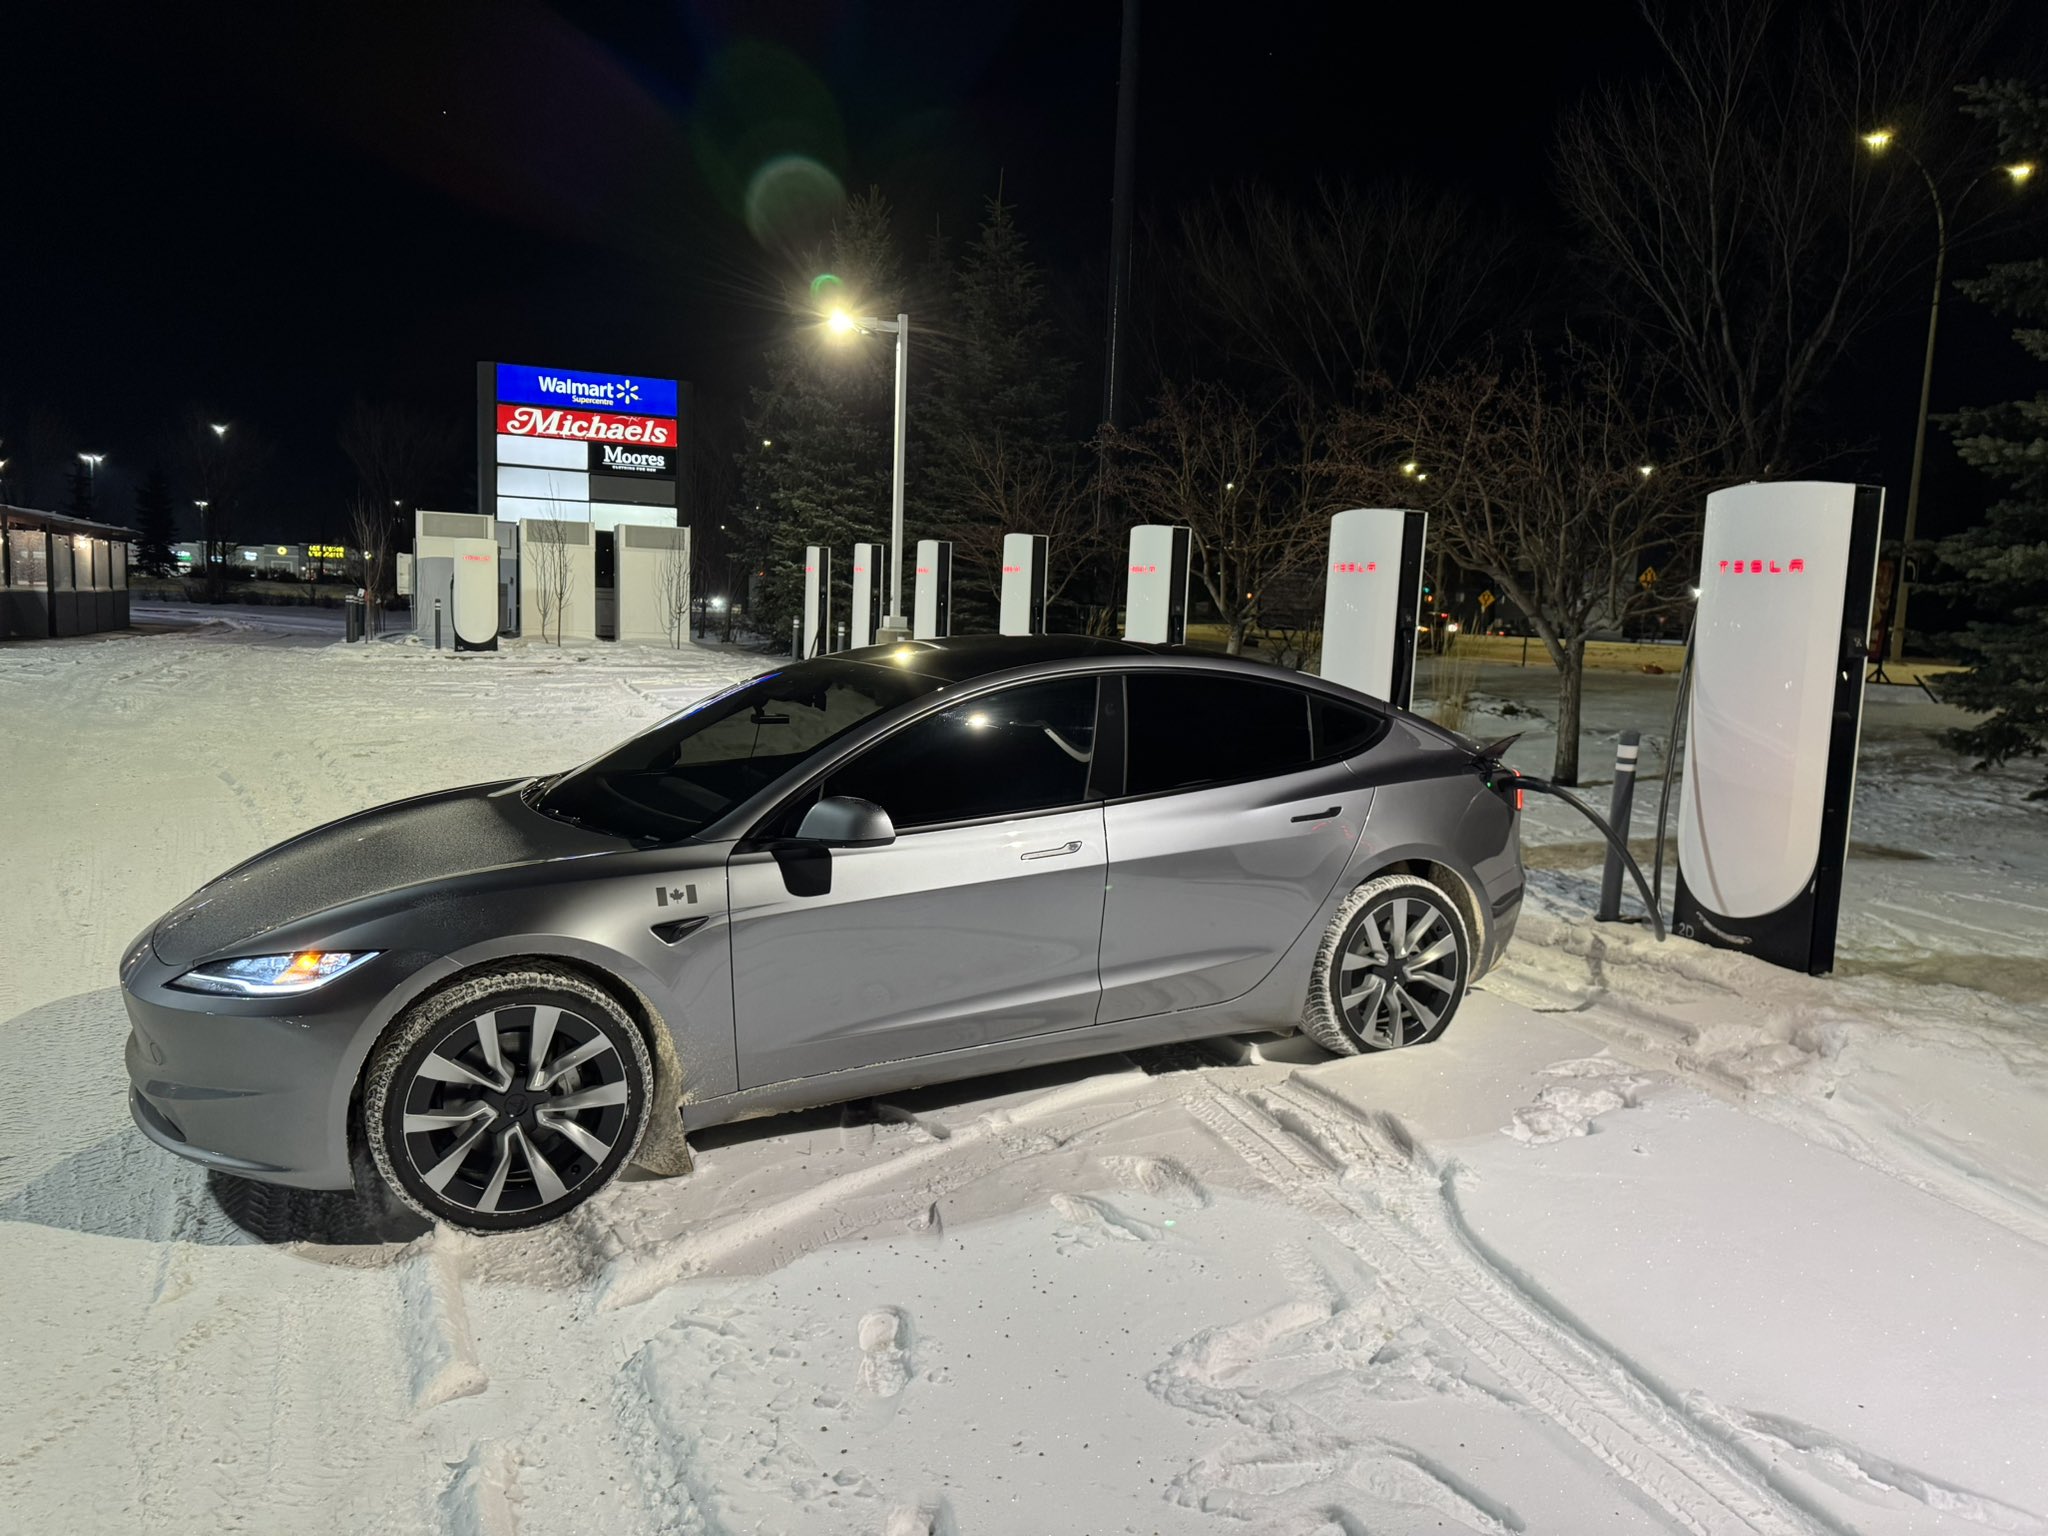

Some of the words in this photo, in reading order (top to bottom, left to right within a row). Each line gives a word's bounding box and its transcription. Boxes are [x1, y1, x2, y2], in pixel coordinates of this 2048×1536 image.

[538, 375, 614, 398] Walmart
[571, 395, 614, 406] Supercentre
[506, 407, 668, 443] Michaels
[603, 445, 665, 467] Moores
[1718, 558, 1805, 576] TESLA
[1678, 921, 1695, 938] 2D
